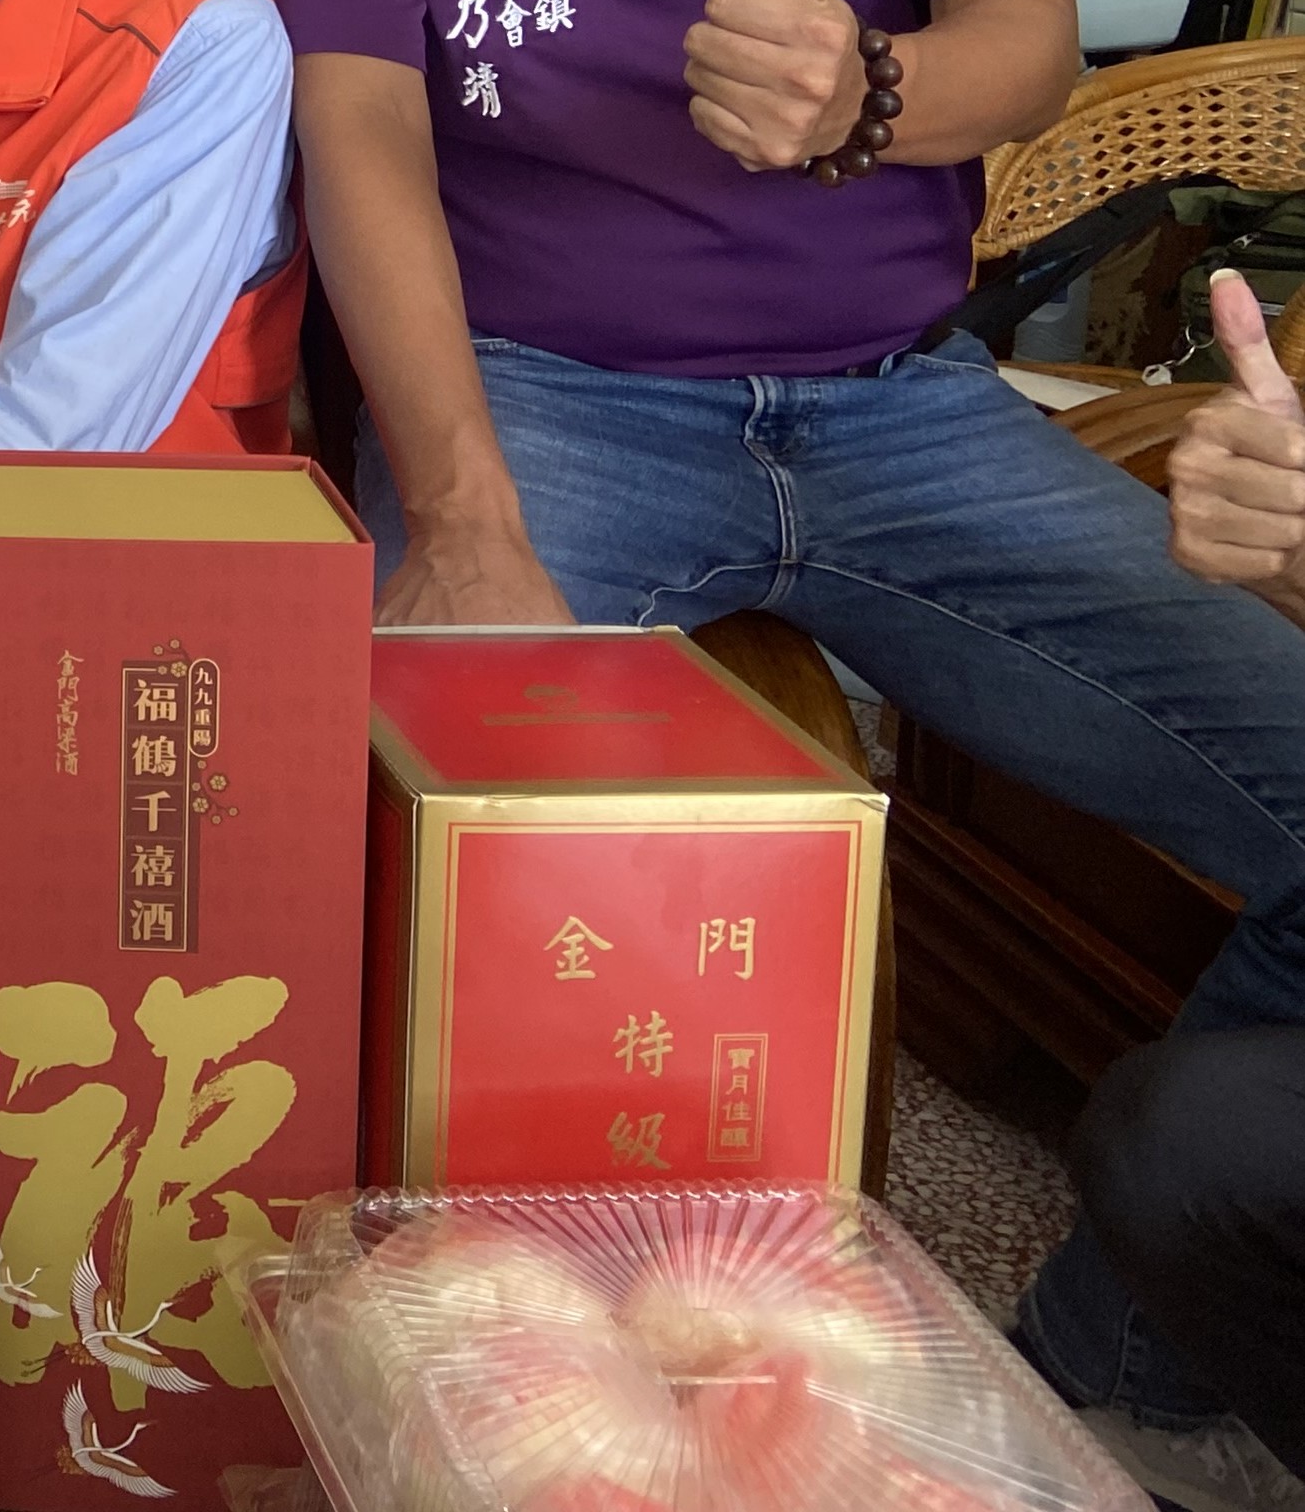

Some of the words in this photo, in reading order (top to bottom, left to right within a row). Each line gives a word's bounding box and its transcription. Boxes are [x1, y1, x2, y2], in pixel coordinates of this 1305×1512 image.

[193, 667, 213, 748] 九九重陽
[129, 679, 178, 941] 福鶴千禧酒
[544, 915, 756, 981] 金門
[607, 1010, 674, 1171] 特級
